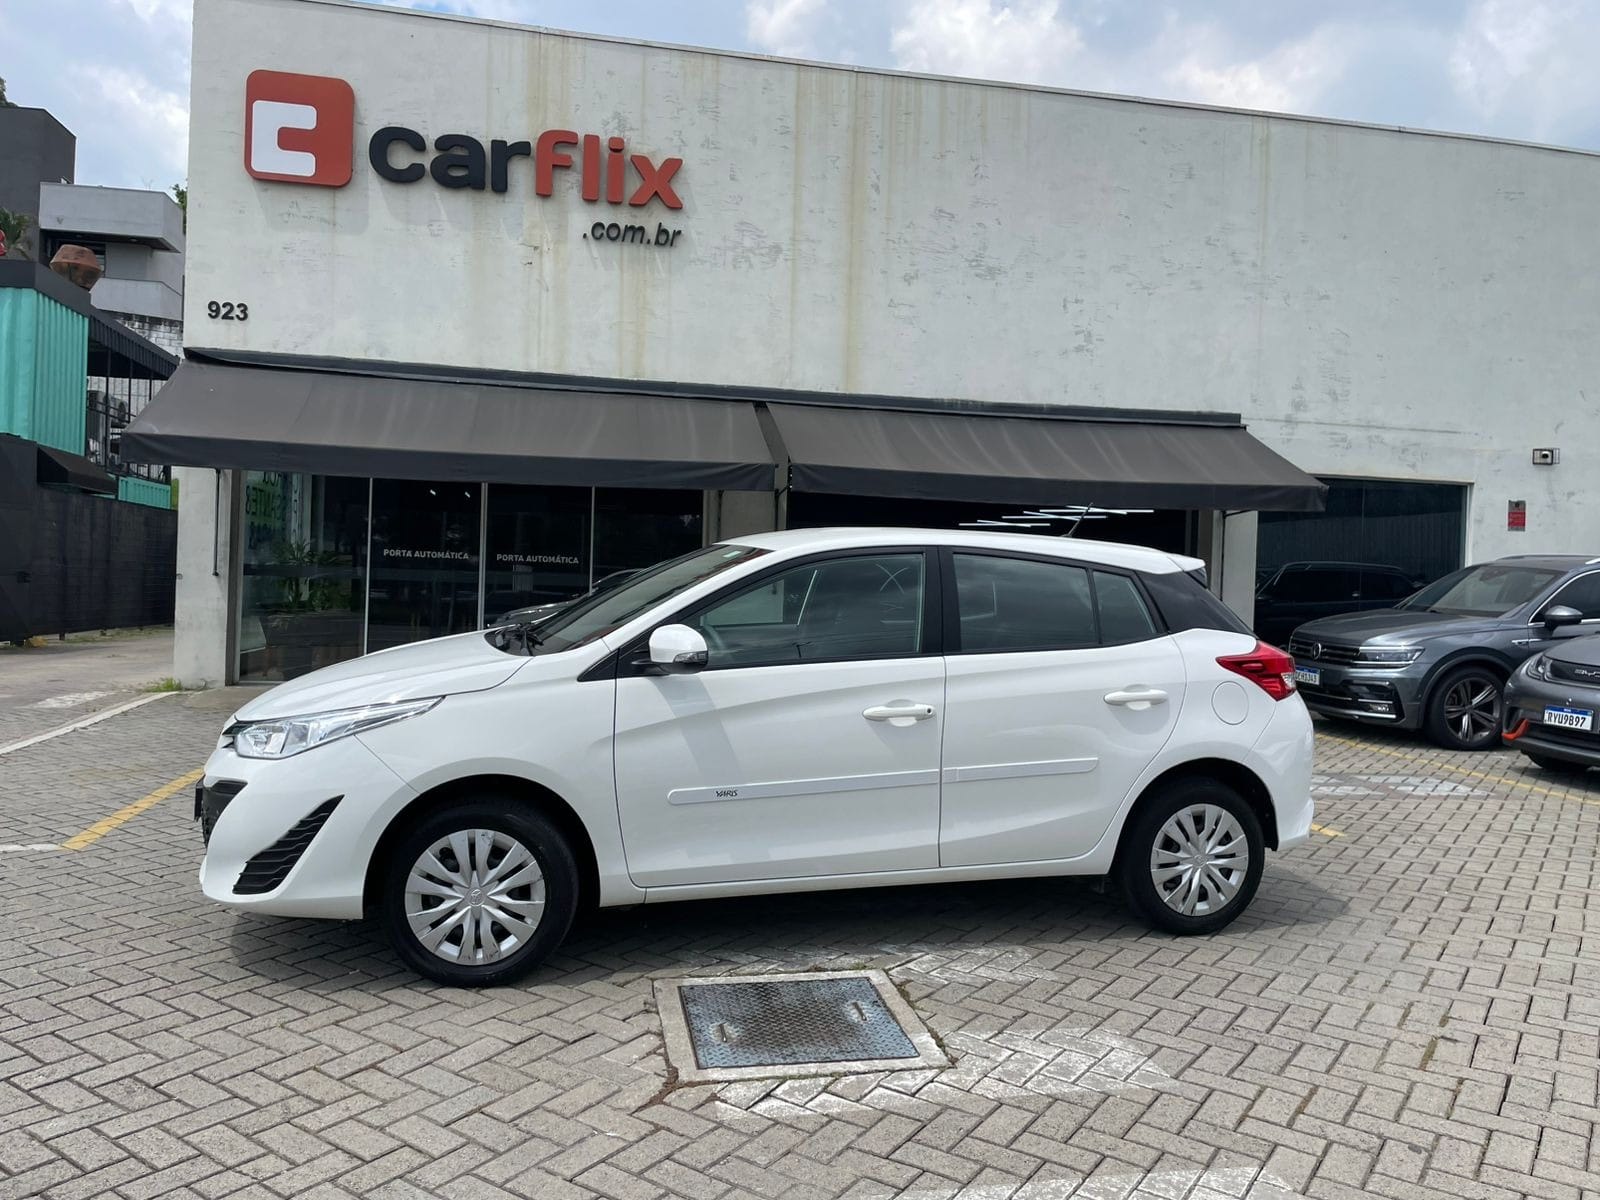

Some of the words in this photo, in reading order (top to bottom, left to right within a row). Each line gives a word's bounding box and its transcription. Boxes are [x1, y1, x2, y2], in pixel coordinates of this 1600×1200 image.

[369, 126, 684, 210] carflix
[582, 221, 683, 247] .com.br
[207, 300, 249, 321] 923
[383, 548, 413, 558] PORTA
[413, 549, 470, 560] AUTOMÁTICA
[496, 553, 525, 562] PORTA
[526, 554, 580, 564] AUTOMÁTICA
[715, 789, 738, 798] YARIS
